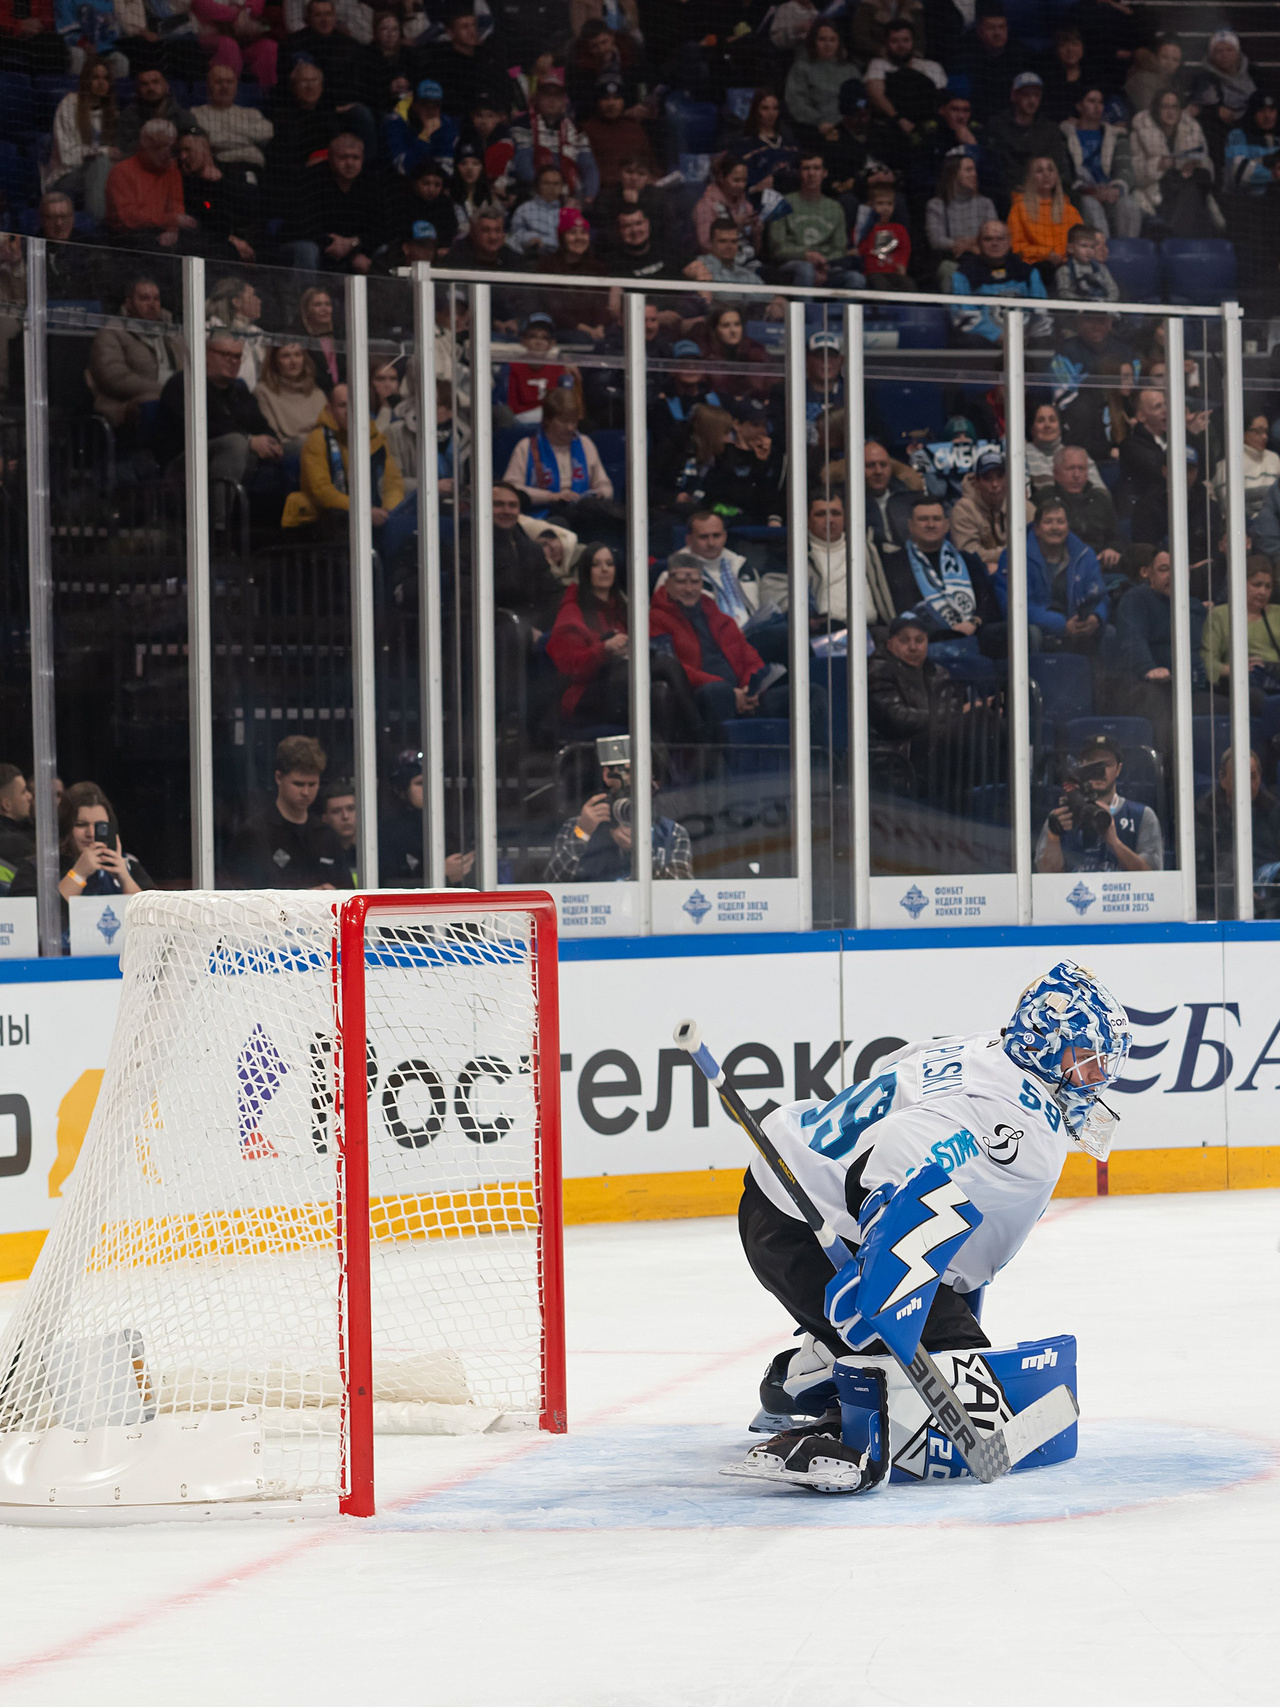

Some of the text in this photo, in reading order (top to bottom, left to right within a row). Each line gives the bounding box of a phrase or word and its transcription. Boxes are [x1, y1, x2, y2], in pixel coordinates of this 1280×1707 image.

[1119, 817, 1136, 834] 91
[934, 886, 964, 895] ФОНБЕТ
[1102, 883, 1131, 892] ФОНБЕТ
[717, 891, 746, 900] ФОНБЕТ
[1102, 892, 1154, 902] НЕДЕЛЯ ЗВЕЗД
[935, 897, 962, 906] НЕДЕЛЯ
[964, 896, 986, 906] ЗВЕЗД
[562, 906, 588, 915] НЕДЕЛЯ
[717, 902, 768, 911] НЕДЕЛЯ ЗВЕЗД
[1102, 903, 1149, 912] ХОККЕЯ 2025
[717, 912, 763, 922] ХОККЕЯ 2025
[935, 907, 981, 917] ХОККЕЯ 2025
[1018, 1077, 1062, 1133] 59
[907, 1352, 976, 1458] AUER
